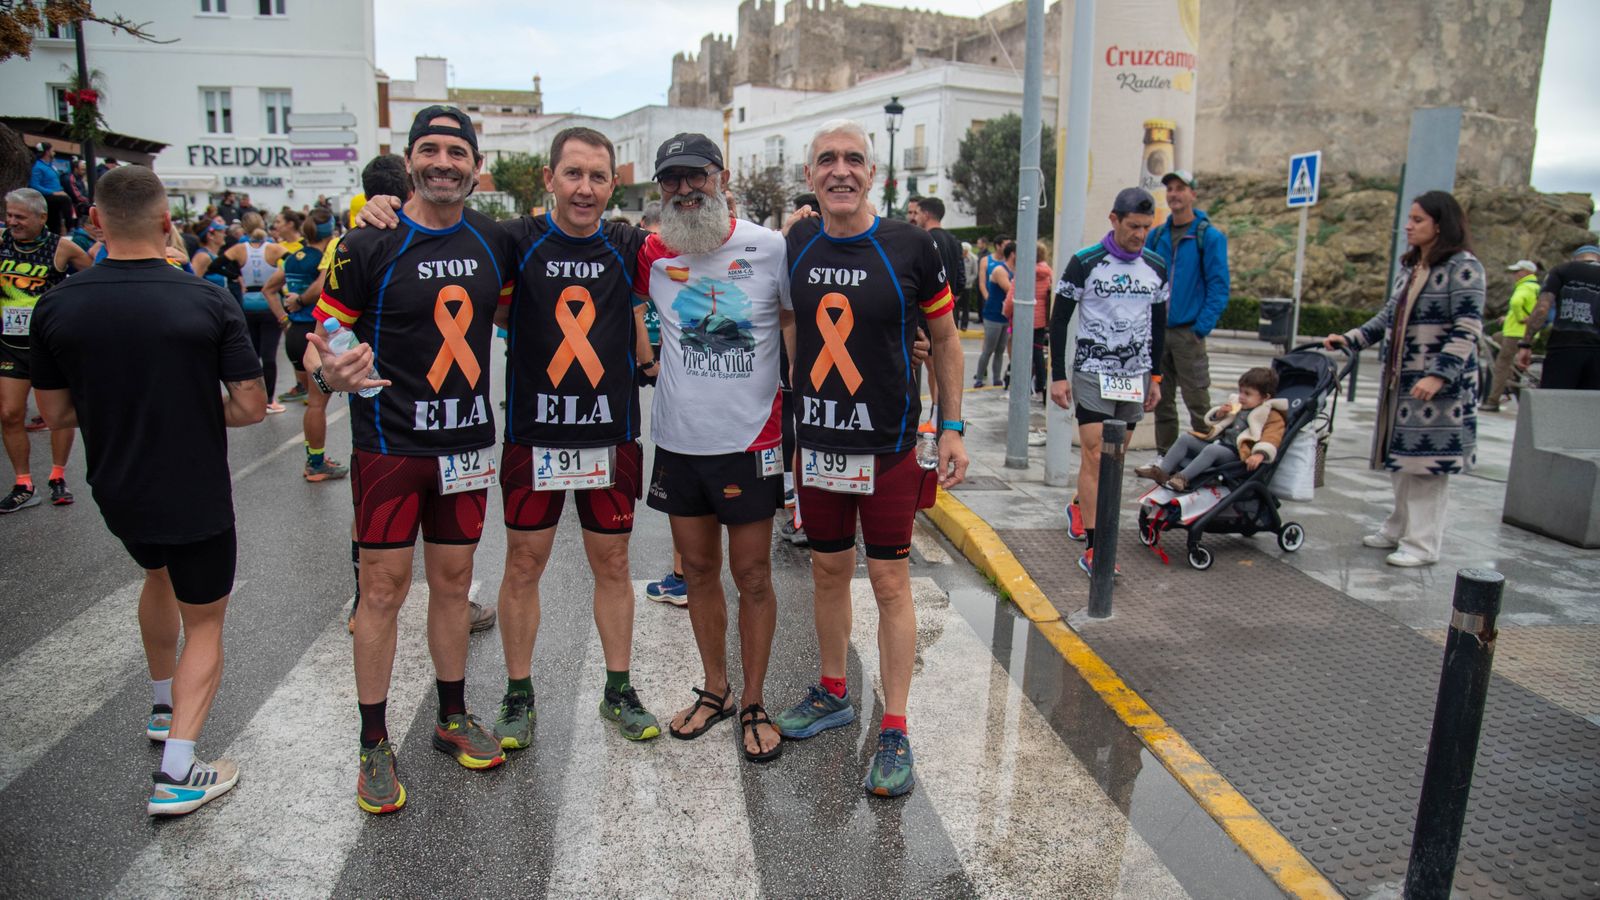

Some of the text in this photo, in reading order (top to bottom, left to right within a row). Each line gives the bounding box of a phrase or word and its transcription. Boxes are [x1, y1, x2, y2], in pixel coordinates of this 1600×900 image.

[1116, 73, 1171, 92] Radler
[187, 145, 311, 168] FREIDUR
[417, 259, 478, 280] STOP
[545, 261, 605, 279] STOP
[808, 267, 867, 287] STOP
[682, 346, 754, 373] Vive la vida
[413, 394, 489, 431] ELA
[534, 393, 613, 424] ELA
[801, 395, 875, 431] ELA
[460, 450, 481, 471] 92
[558, 449, 581, 471] 91
[824, 452, 847, 473] 99
